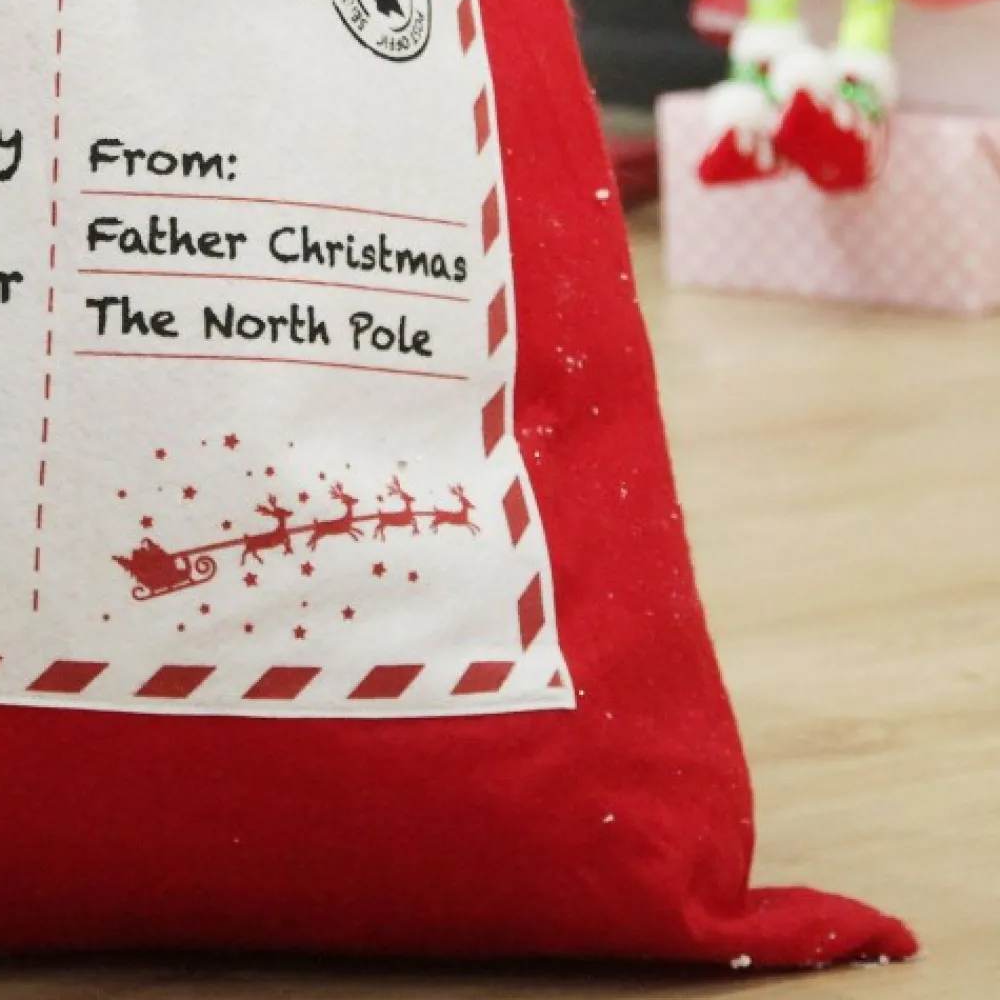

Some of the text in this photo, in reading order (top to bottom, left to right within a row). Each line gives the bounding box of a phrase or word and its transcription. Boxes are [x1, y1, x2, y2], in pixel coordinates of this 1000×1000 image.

[88, 138, 237, 182] From:
[86, 214, 467, 283] Father Christmas
[85, 296, 433, 357] The North Pole
